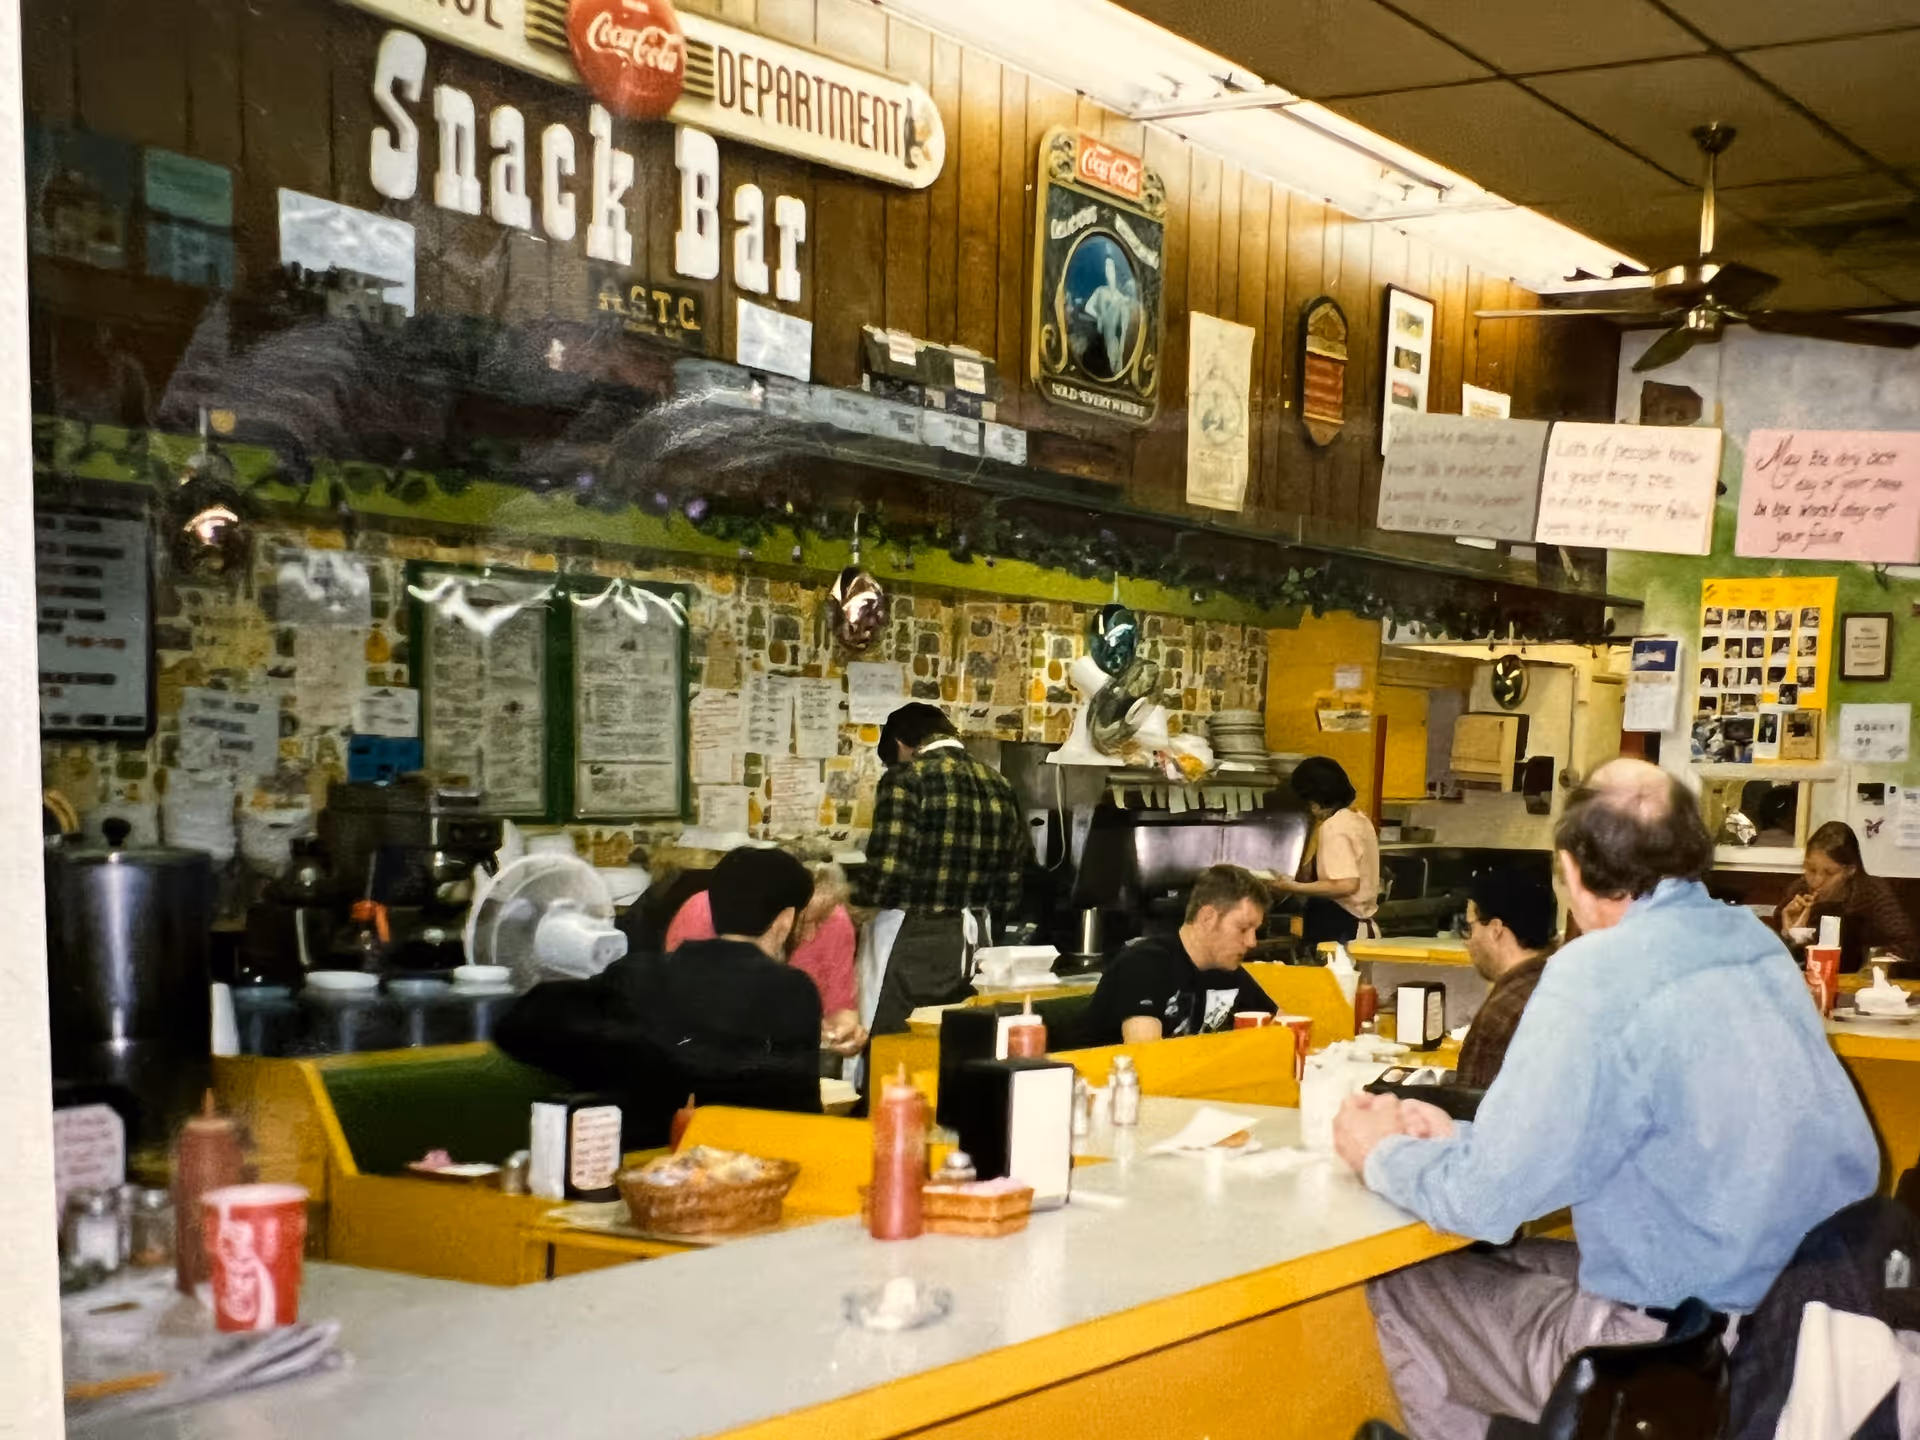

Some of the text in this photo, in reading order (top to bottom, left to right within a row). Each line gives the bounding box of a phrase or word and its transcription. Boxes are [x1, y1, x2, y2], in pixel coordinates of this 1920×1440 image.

[717, 45, 905, 157] DEPARTMENT
[369, 30, 806, 302] Snack Bar
[1756, 434, 1803, 489] May
